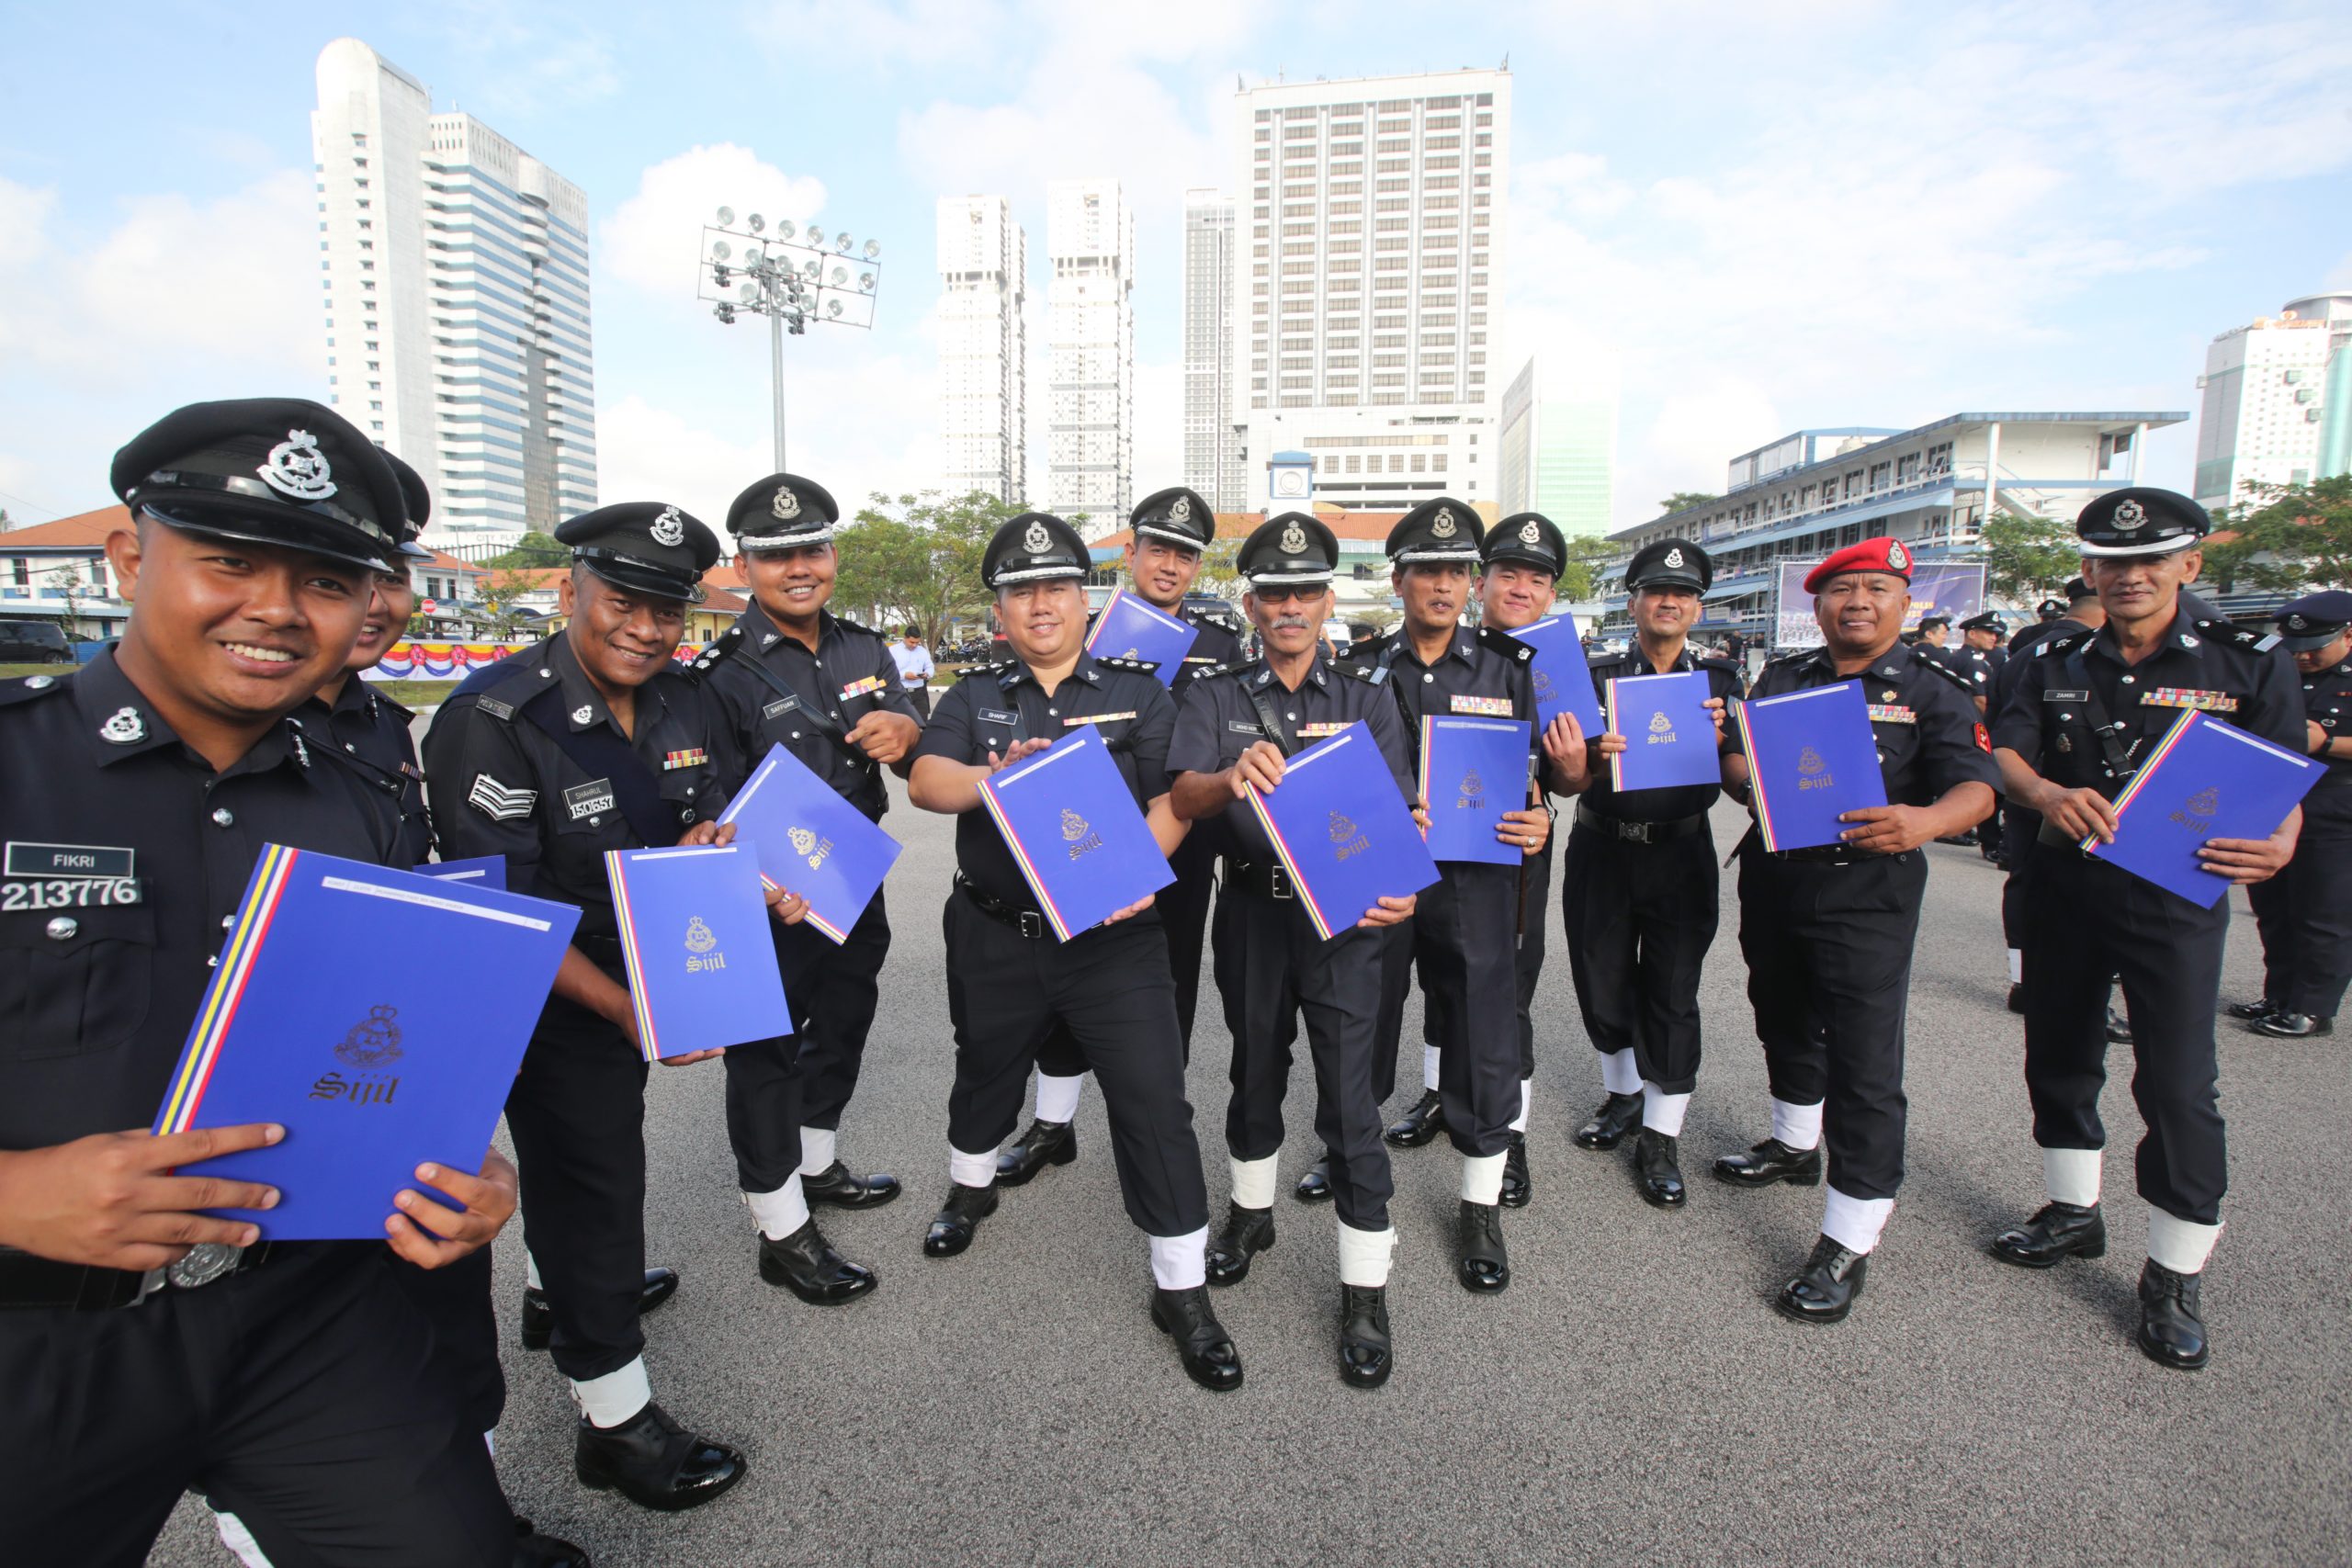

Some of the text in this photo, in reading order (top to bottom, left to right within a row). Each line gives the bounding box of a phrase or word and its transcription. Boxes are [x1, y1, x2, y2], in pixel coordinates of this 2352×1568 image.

[477, 534, 522, 542] CITY PLAZ
[1646, 731, 1677, 745] Sijil
[575, 786, 603, 800] SHAHRUL
[1799, 773, 1835, 791] Sijil
[570, 795, 614, 819] 150657
[808, 836, 834, 871] Sijil
[1069, 831, 1103, 862] Sijil
[1336, 834, 1371, 863] Sijil
[53, 853, 95, 868] FIKRI
[0, 878, 137, 911] 213776
[685, 951, 727, 974] Sijil
[308, 1071, 401, 1109] Sijil
